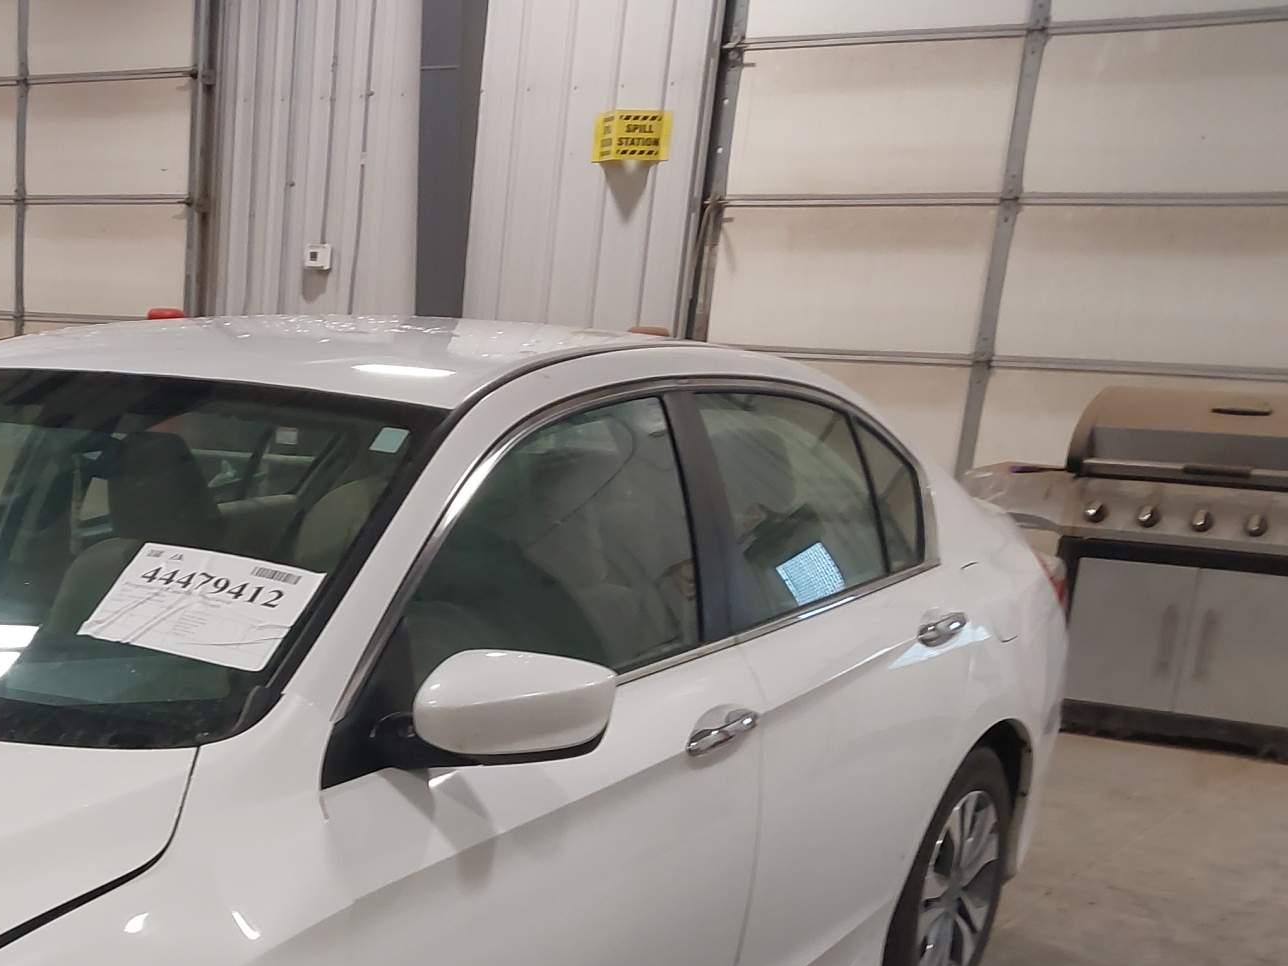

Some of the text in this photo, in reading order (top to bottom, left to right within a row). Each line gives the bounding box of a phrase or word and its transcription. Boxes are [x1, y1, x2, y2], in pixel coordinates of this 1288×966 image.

[625, 124, 654, 133] SPILL
[617, 137, 660, 146] STATION
[141, 566, 284, 609] 44479412
